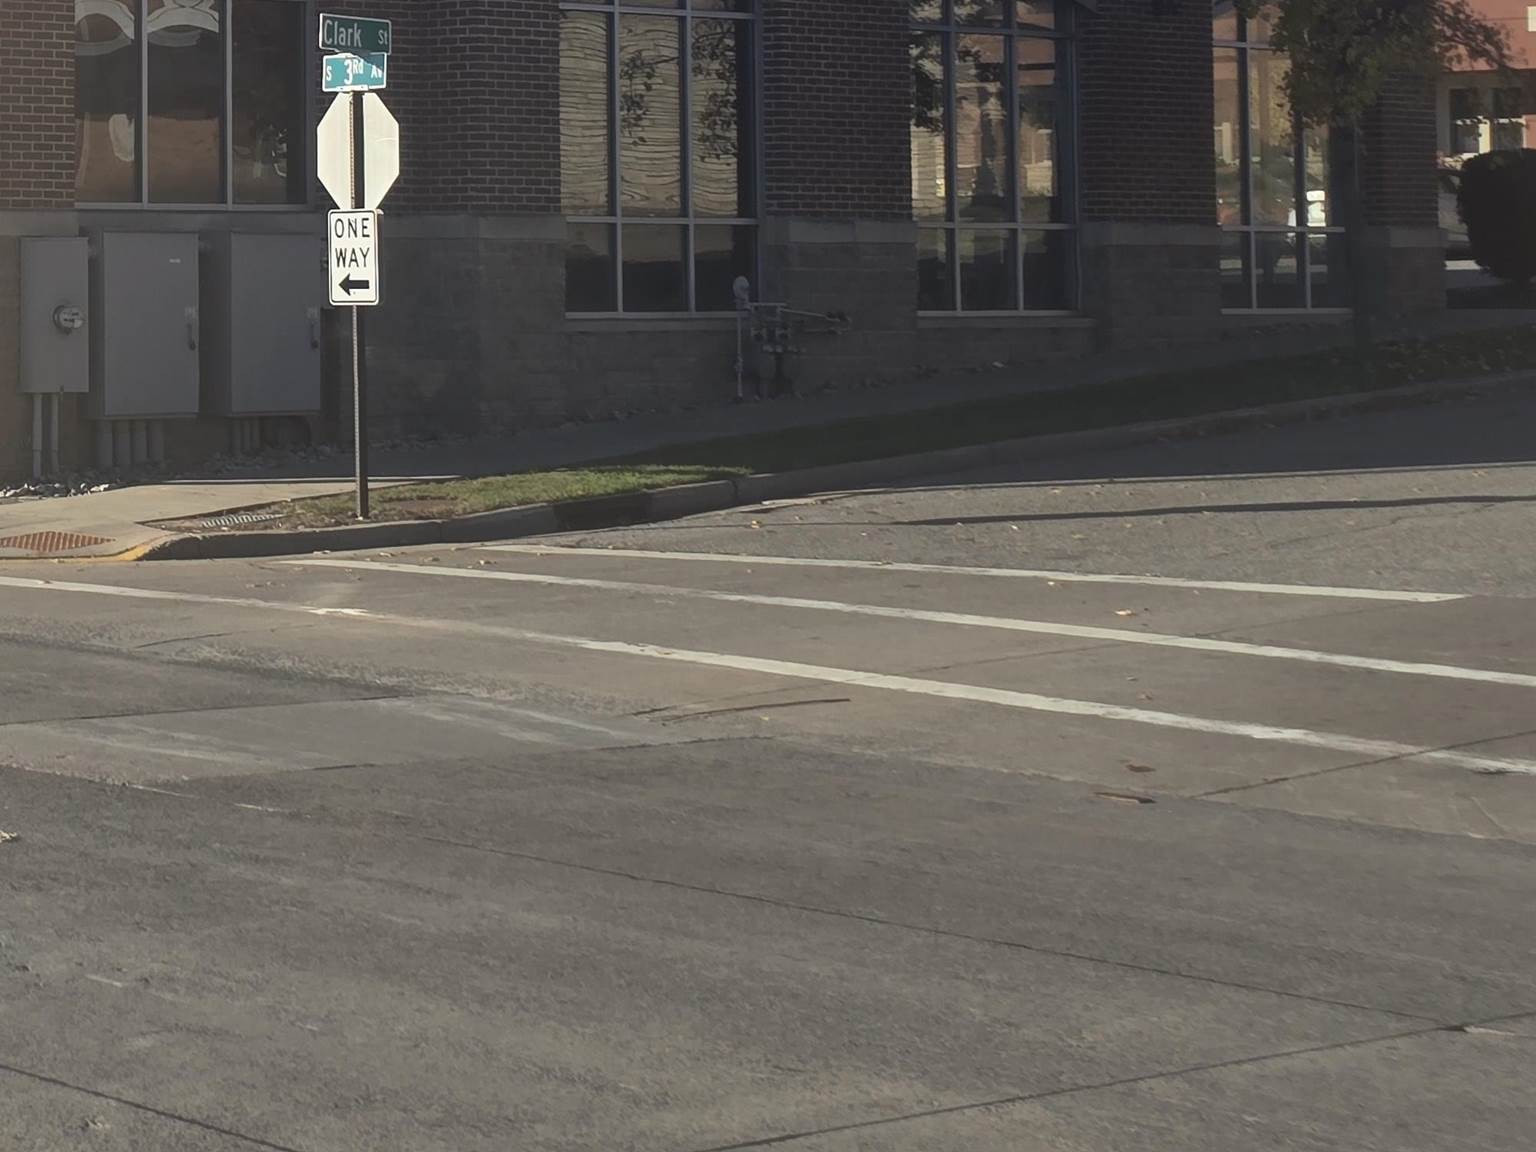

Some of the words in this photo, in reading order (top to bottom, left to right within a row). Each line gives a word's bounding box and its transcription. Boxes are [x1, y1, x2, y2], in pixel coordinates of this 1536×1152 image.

[324, 20, 362, 47] Clark
[378, 30, 388, 45] St
[326, 65, 332, 81] S
[334, 218, 370, 238] ONE
[335, 247, 370, 268] WAY
